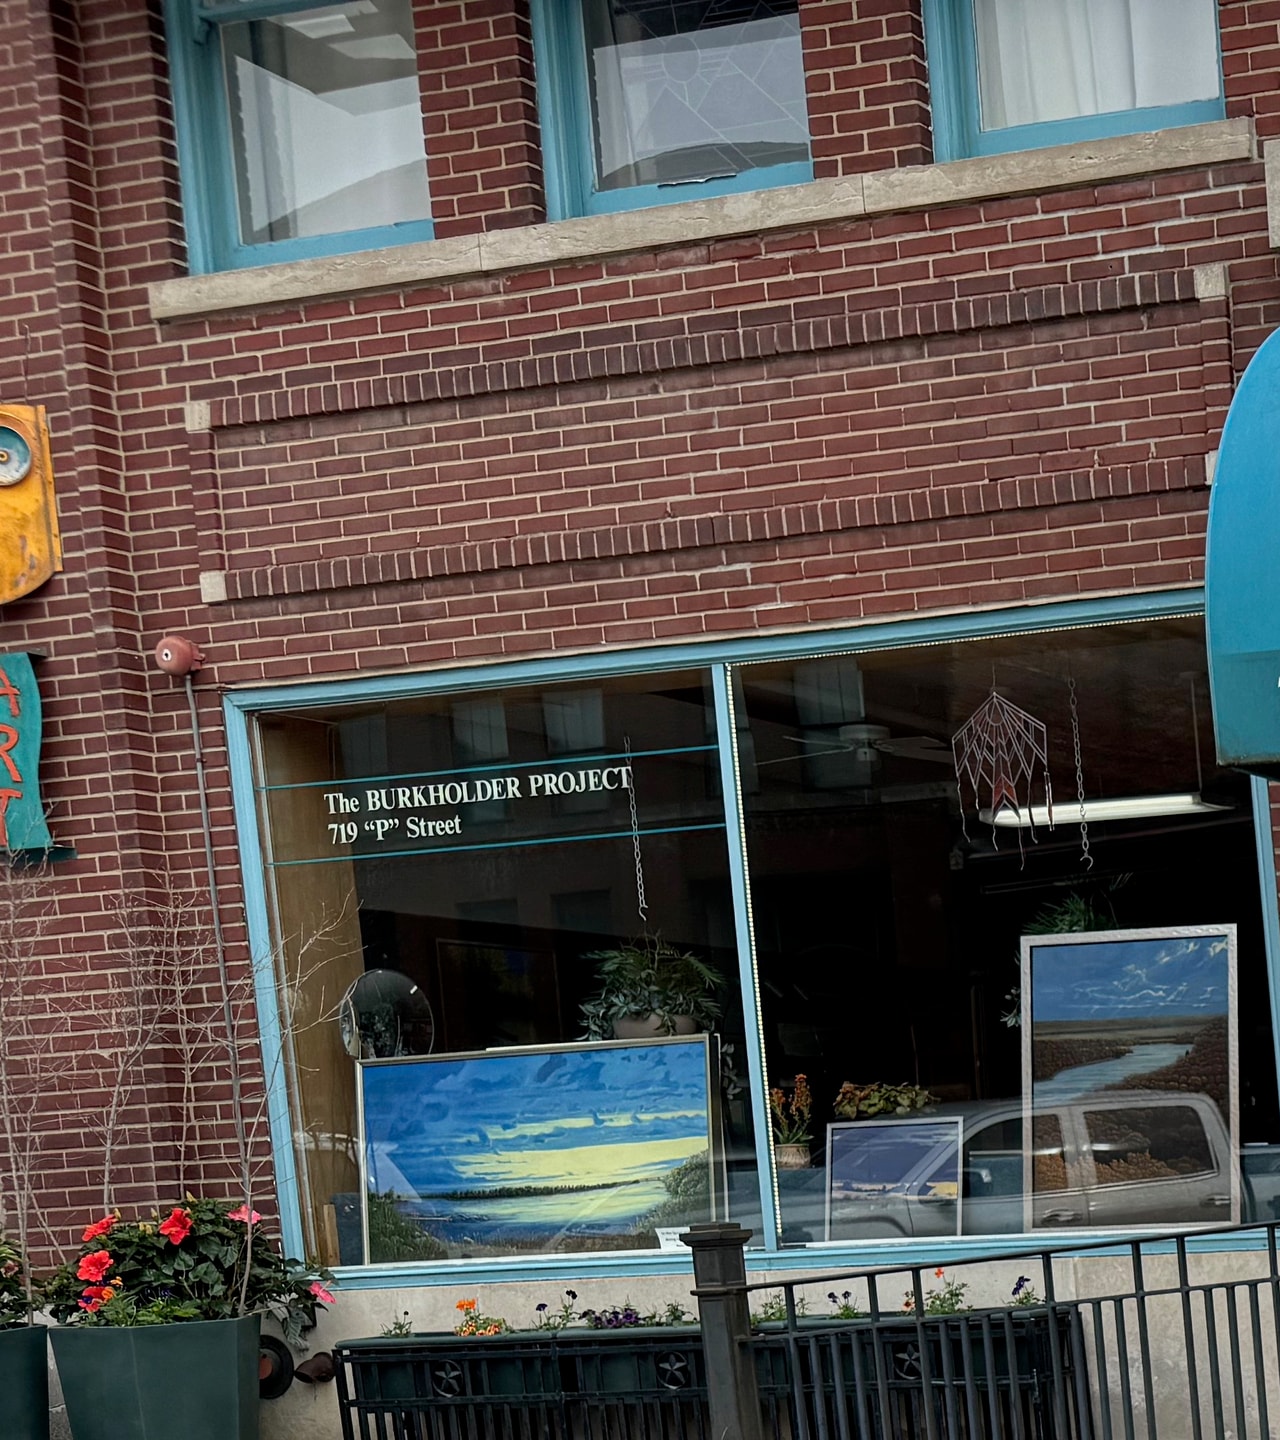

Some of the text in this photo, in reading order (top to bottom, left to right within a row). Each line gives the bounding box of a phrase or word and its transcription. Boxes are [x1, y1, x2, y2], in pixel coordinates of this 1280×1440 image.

[323, 766, 633, 815] The BURKHOLDER PROJECT
[327, 821, 359, 845] 719
[406, 814, 463, 839] Street
